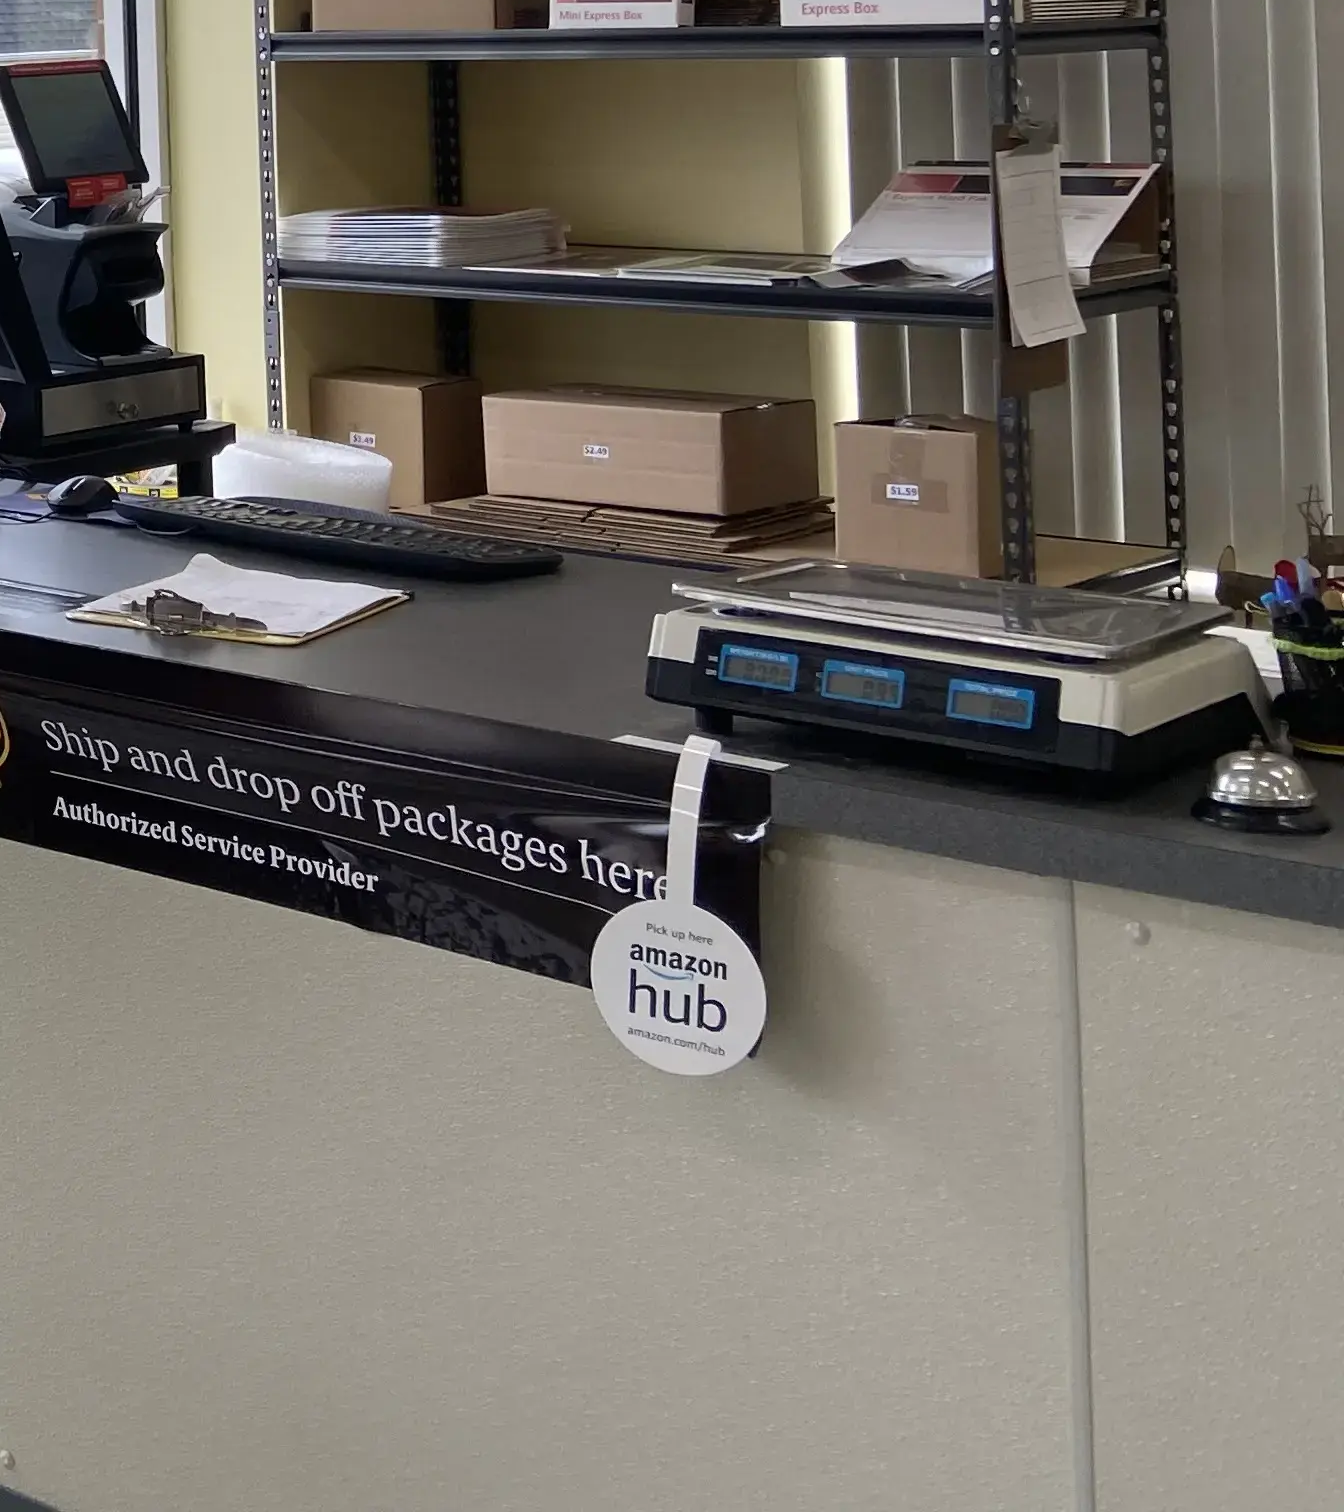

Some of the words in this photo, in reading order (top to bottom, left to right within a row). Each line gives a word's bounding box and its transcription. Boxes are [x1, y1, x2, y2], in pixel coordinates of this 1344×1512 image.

[559, 10, 580, 21] Mini
[584, 10, 620, 23] Express
[623, 9, 643, 20] Box
[802, 3, 849, 17] Express
[854, 1, 879, 15] Box
[40, 719, 120, 772] Ship
[128, 745, 200, 783] and
[207, 756, 300, 813] drop
[312, 780, 366, 821] off
[373, 797, 568, 872] packages
[52, 796, 177, 844] Authorized
[181, 825, 265, 865] Service
[269, 845, 379, 893] Provider
[646, 922, 668, 936] Pick
[672, 930, 685, 941] up
[689, 932, 713, 945] here
[630, 943, 728, 980] amazon
[629, 968, 727, 1032] hub
[628, 1026, 725, 1056] amazon.com/hub
